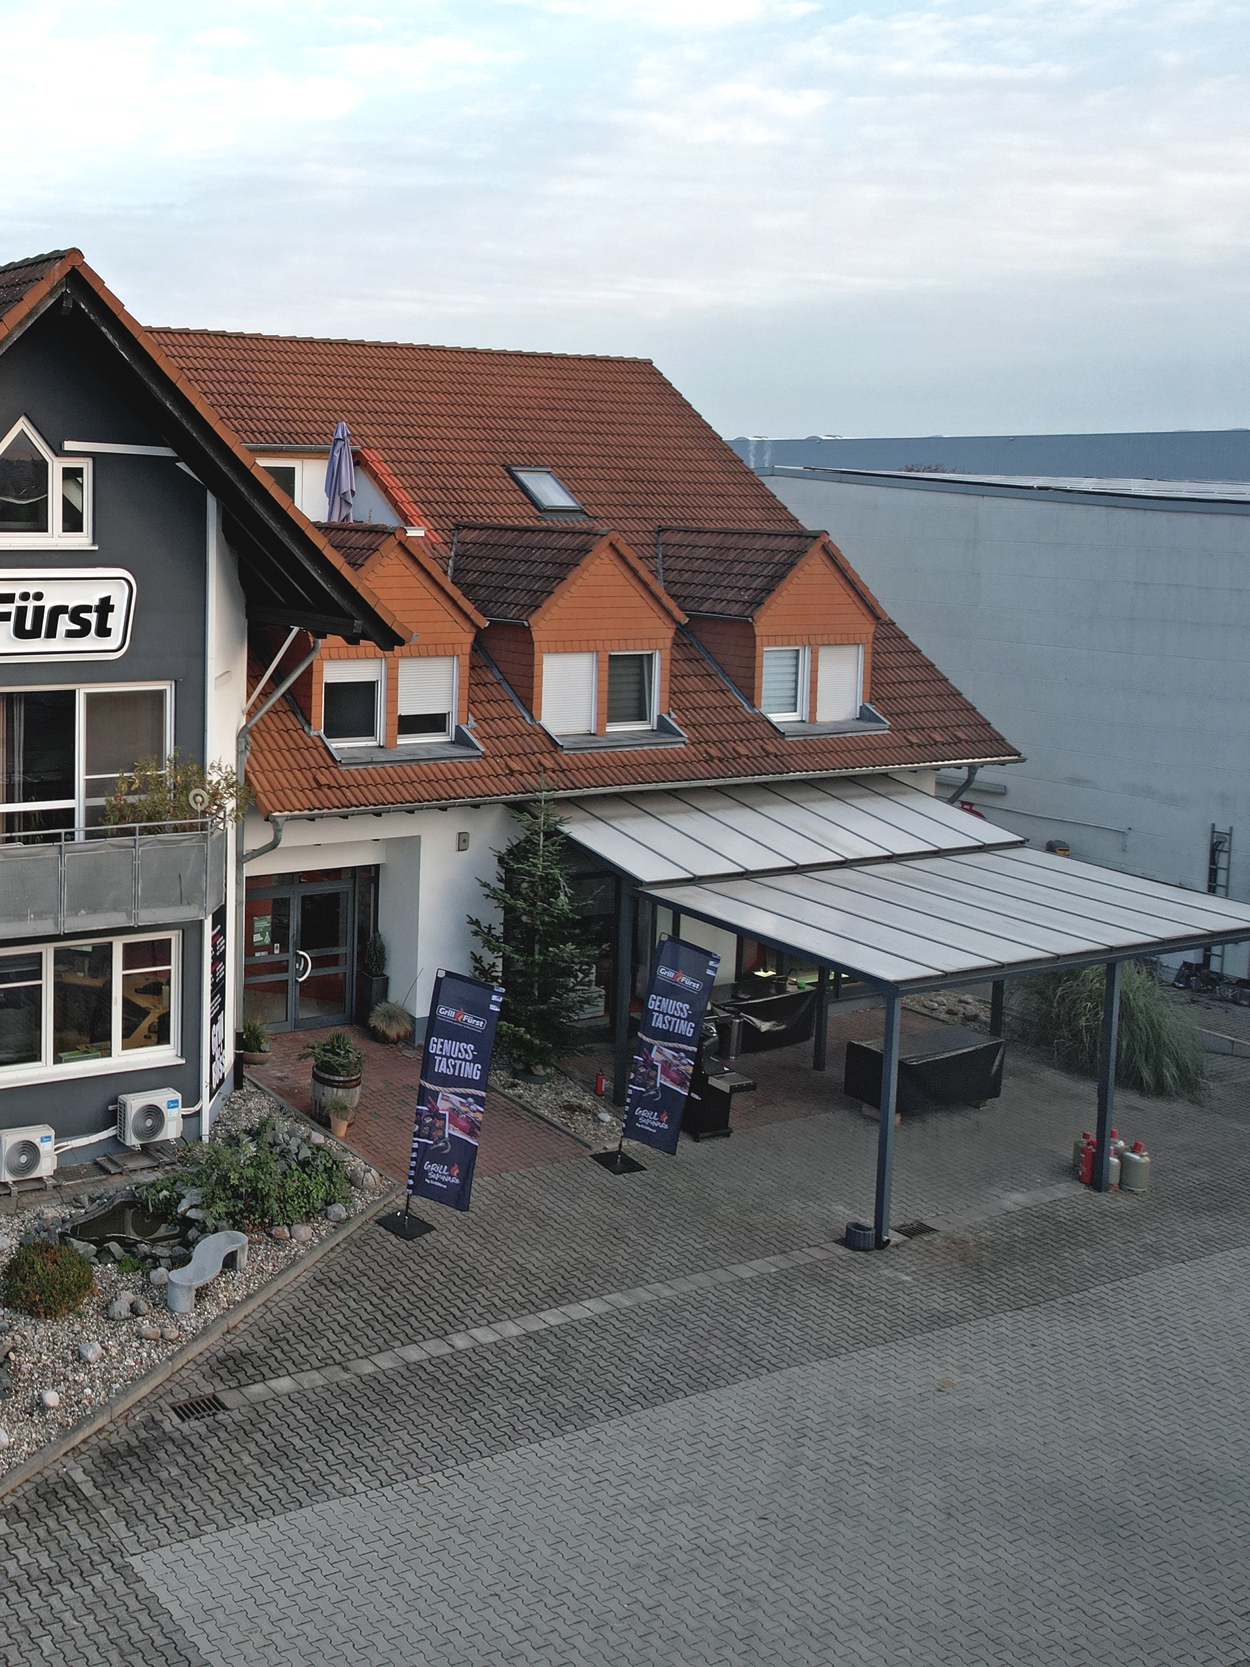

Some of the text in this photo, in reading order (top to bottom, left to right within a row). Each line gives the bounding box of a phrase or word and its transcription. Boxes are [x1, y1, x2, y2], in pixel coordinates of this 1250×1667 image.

[659, 968, 675, 978] Grill
[681, 976, 701, 989] Fürst
[438, 1007, 455, 1018] Grill
[462, 1014, 484, 1027] Fürst
[647, 994, 693, 1018] GENUSS-
[651, 1011, 695, 1037] TASTING
[428, 1036, 478, 1060] GENUSS-
[434, 1056, 482, 1080] TASTING
